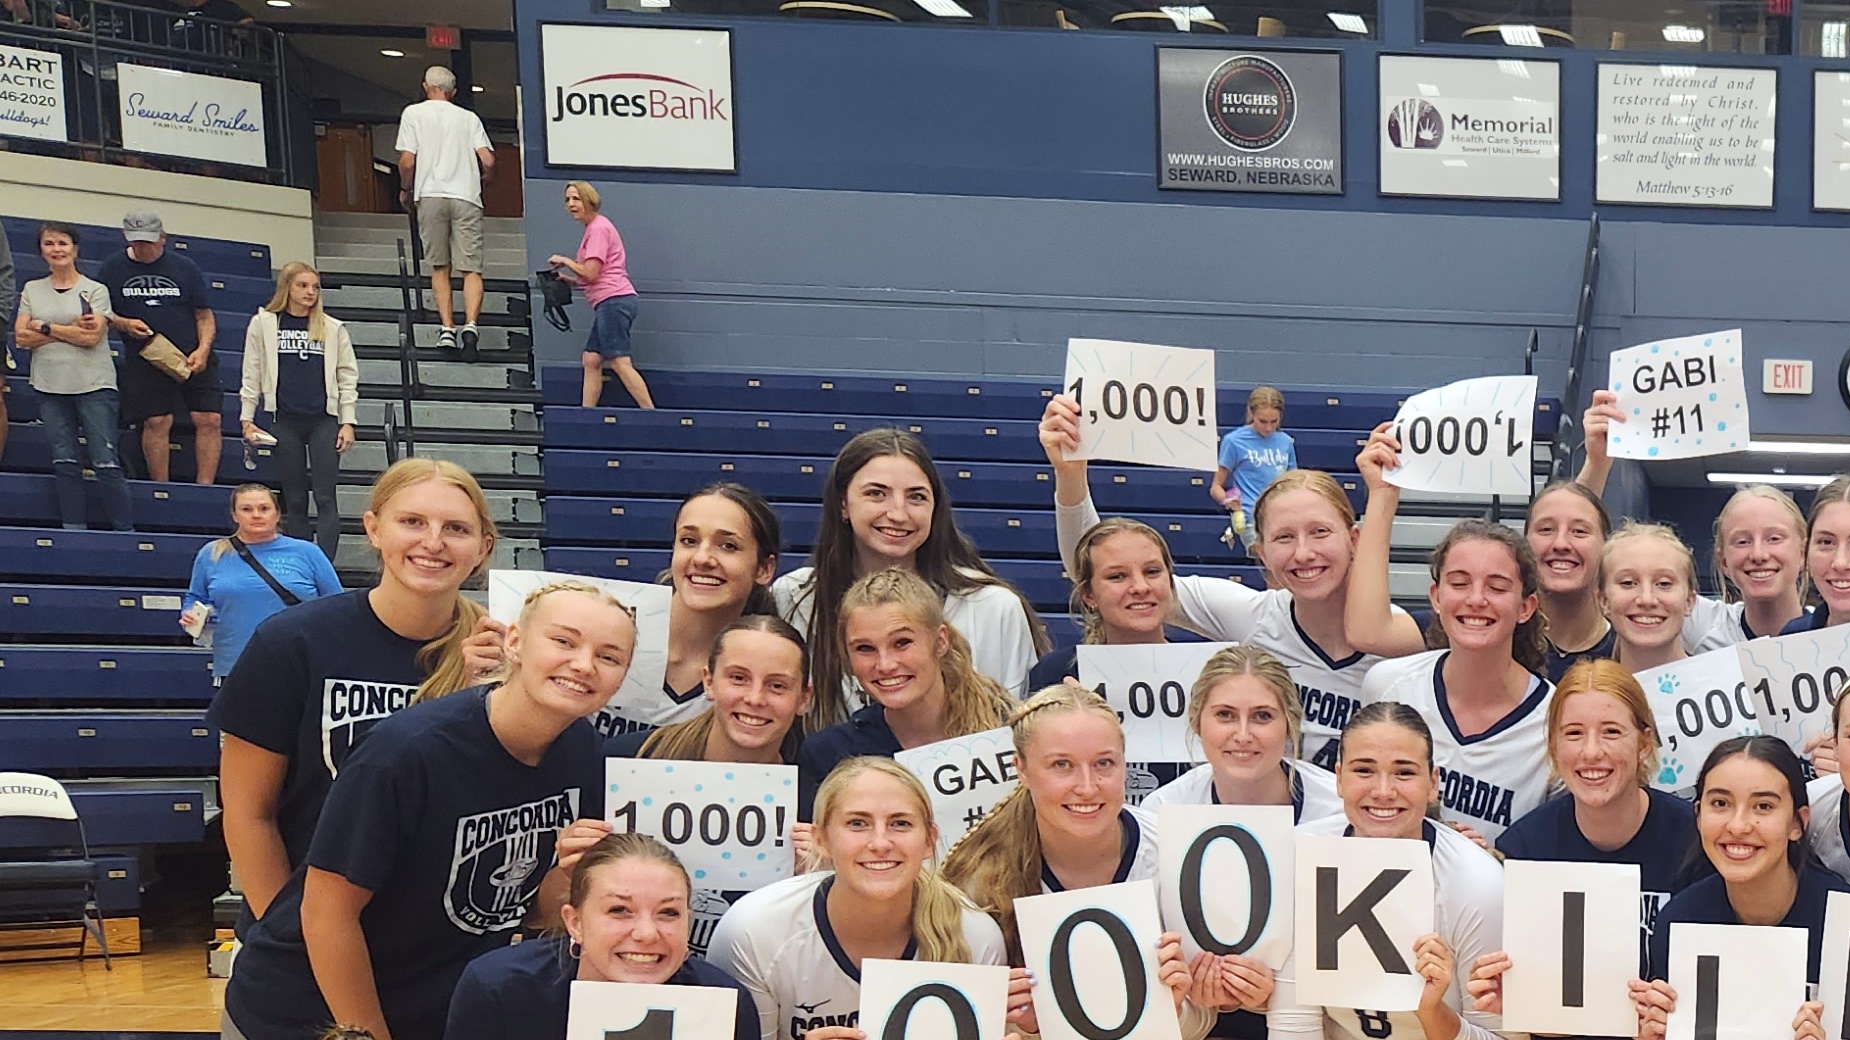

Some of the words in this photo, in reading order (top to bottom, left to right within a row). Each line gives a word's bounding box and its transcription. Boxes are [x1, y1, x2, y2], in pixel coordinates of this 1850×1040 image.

[1613, 73, 1643, 86] Live
[1653, 75, 1718, 89] redeemed
[1727, 77, 1755, 90] and
[1222, 93, 1278, 106] HUGHES
[1613, 93, 1671, 107] restored
[1681, 95, 1698, 112] by
[126, 92, 198, 124] Seward
[201, 103, 260, 132] Smiles
[1222, 107, 1278, 115] BROTHERS
[152, 121, 183, 131] FAMILY
[188, 126, 235, 137] DENTISTRY
[1451, 114, 1552, 134] Memorial
[1613, 111, 1639, 125] who
[1645, 113, 1656, 125] is
[1661, 112, 1681, 126] the
[1686, 114, 1716, 132] light
[1721, 114, 1738, 131] of
[1740, 116, 1759, 130] the
[1451, 134, 1484, 144] Health
[1487, 135, 1510, 145] Care
[1513, 137, 1553, 147] Systems
[1613, 131, 1649, 145] world
[1652, 133, 1704, 152] enabling
[1709, 138, 1723, 147] us
[1728, 136, 1740, 148] to
[1745, 135, 1759, 149] be
[1168, 153, 1334, 170] WWW.HUGHESBROS.COM
[1612, 150, 1633, 164] salt
[1637, 151, 1659, 164] and
[1661, 152, 1687, 170] light
[1690, 154, 1701, 166] in
[1704, 153, 1721, 167] the
[1168, 168, 1241, 184] SEWARD,
[1247, 171, 1335, 187] NEBRASKA
[1636, 180, 1691, 195] Matthew
[1692, 184, 1734, 199] 5:13-16
[122, 287, 182, 297] BULLDOGS
[1632, 355, 1716, 394] GABI
[1773, 364, 1804, 389] EXIT
[1069, 377, 1206, 427] 1,000!
[1652, 403, 1703, 438] #11
[614, 800, 787, 848] 1000!
